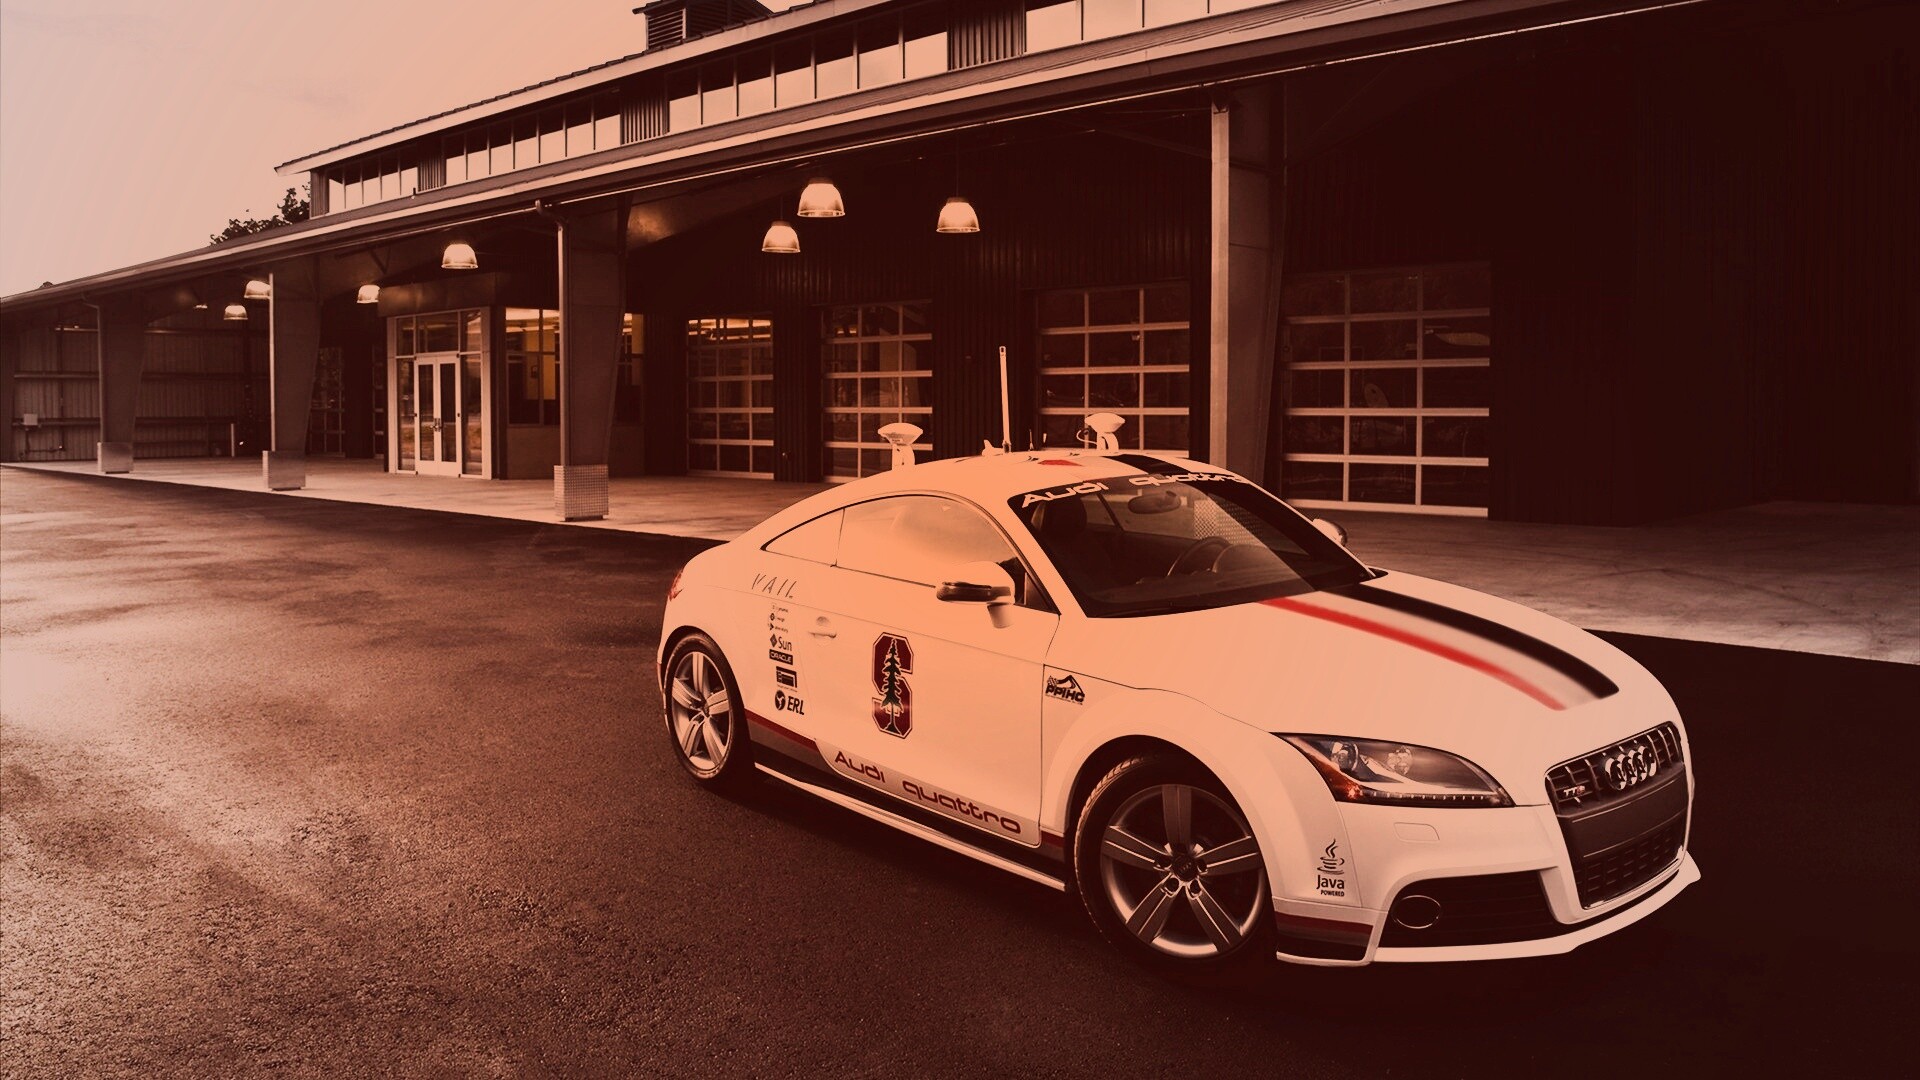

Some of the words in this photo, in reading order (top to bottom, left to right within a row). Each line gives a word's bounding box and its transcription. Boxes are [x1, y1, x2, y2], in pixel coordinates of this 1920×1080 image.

[1022, 482, 1109, 508] Audi
[752, 573, 797, 598] VAIL
[778, 636, 793, 652] Sun
[770, 651, 792, 663] ORACLE
[787, 695, 805, 715] ERL
[834, 750, 886, 783] Audi
[902, 780, 1021, 835] quattro
[1316, 874, 1344, 889] Java
